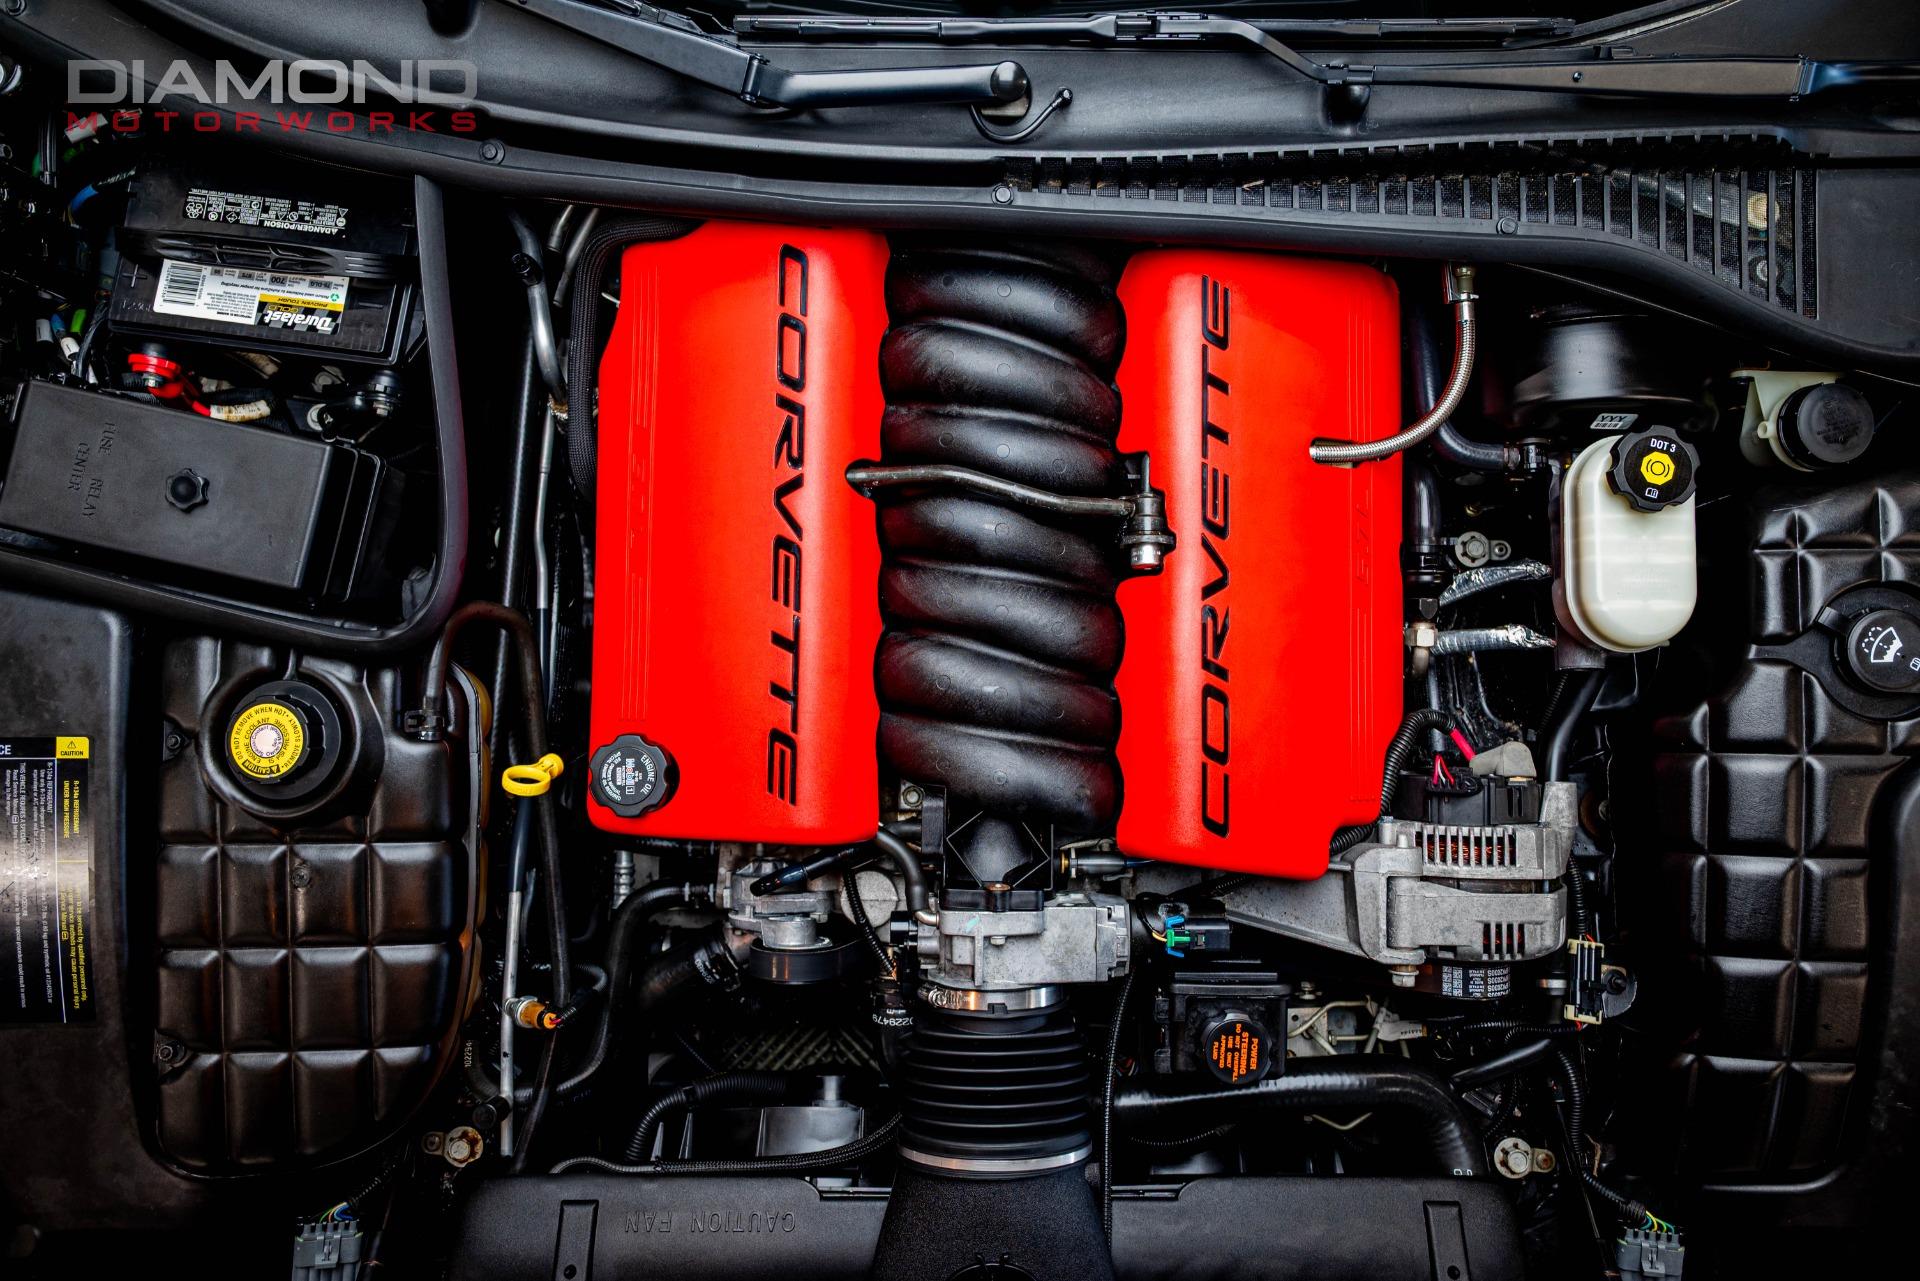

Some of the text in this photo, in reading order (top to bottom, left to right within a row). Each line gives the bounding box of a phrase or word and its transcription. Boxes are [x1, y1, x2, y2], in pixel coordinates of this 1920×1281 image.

[271, 276, 286, 284] 700
[263, 310, 333, 331] Duralast
[268, 304, 299, 313] GOLD
[1650, 438, 1676, 452] DOT 3
[68, 442, 90, 491] CENTER
[82, 422, 117, 520] FUSE RELAY
[766, 242, 812, 808] CORVETTE
[1200, 275, 1235, 838] CORVETTE
[235, 712, 254, 735] REMOVE
[254, 707, 273, 715] WHEN
[274, 708, 287, 717] HOT
[274, 719, 290, 751] PRESSURE
[244, 717, 270, 763] ENGINE COOLANT
[284, 719, 301, 768] REMOVE SLOWLY
[243, 759, 271, 774] CAUTION
[626, 759, 635, 785] Mobil
[640, 755, 655, 794] ENGINE OIL
[1236, 1024, 1242, 1033] DO
[1240, 1032, 1249, 1074] STEERING
[1250, 1038, 1258, 1070] POWER
[624, 1211, 796, 1233] CAUTION FAN
